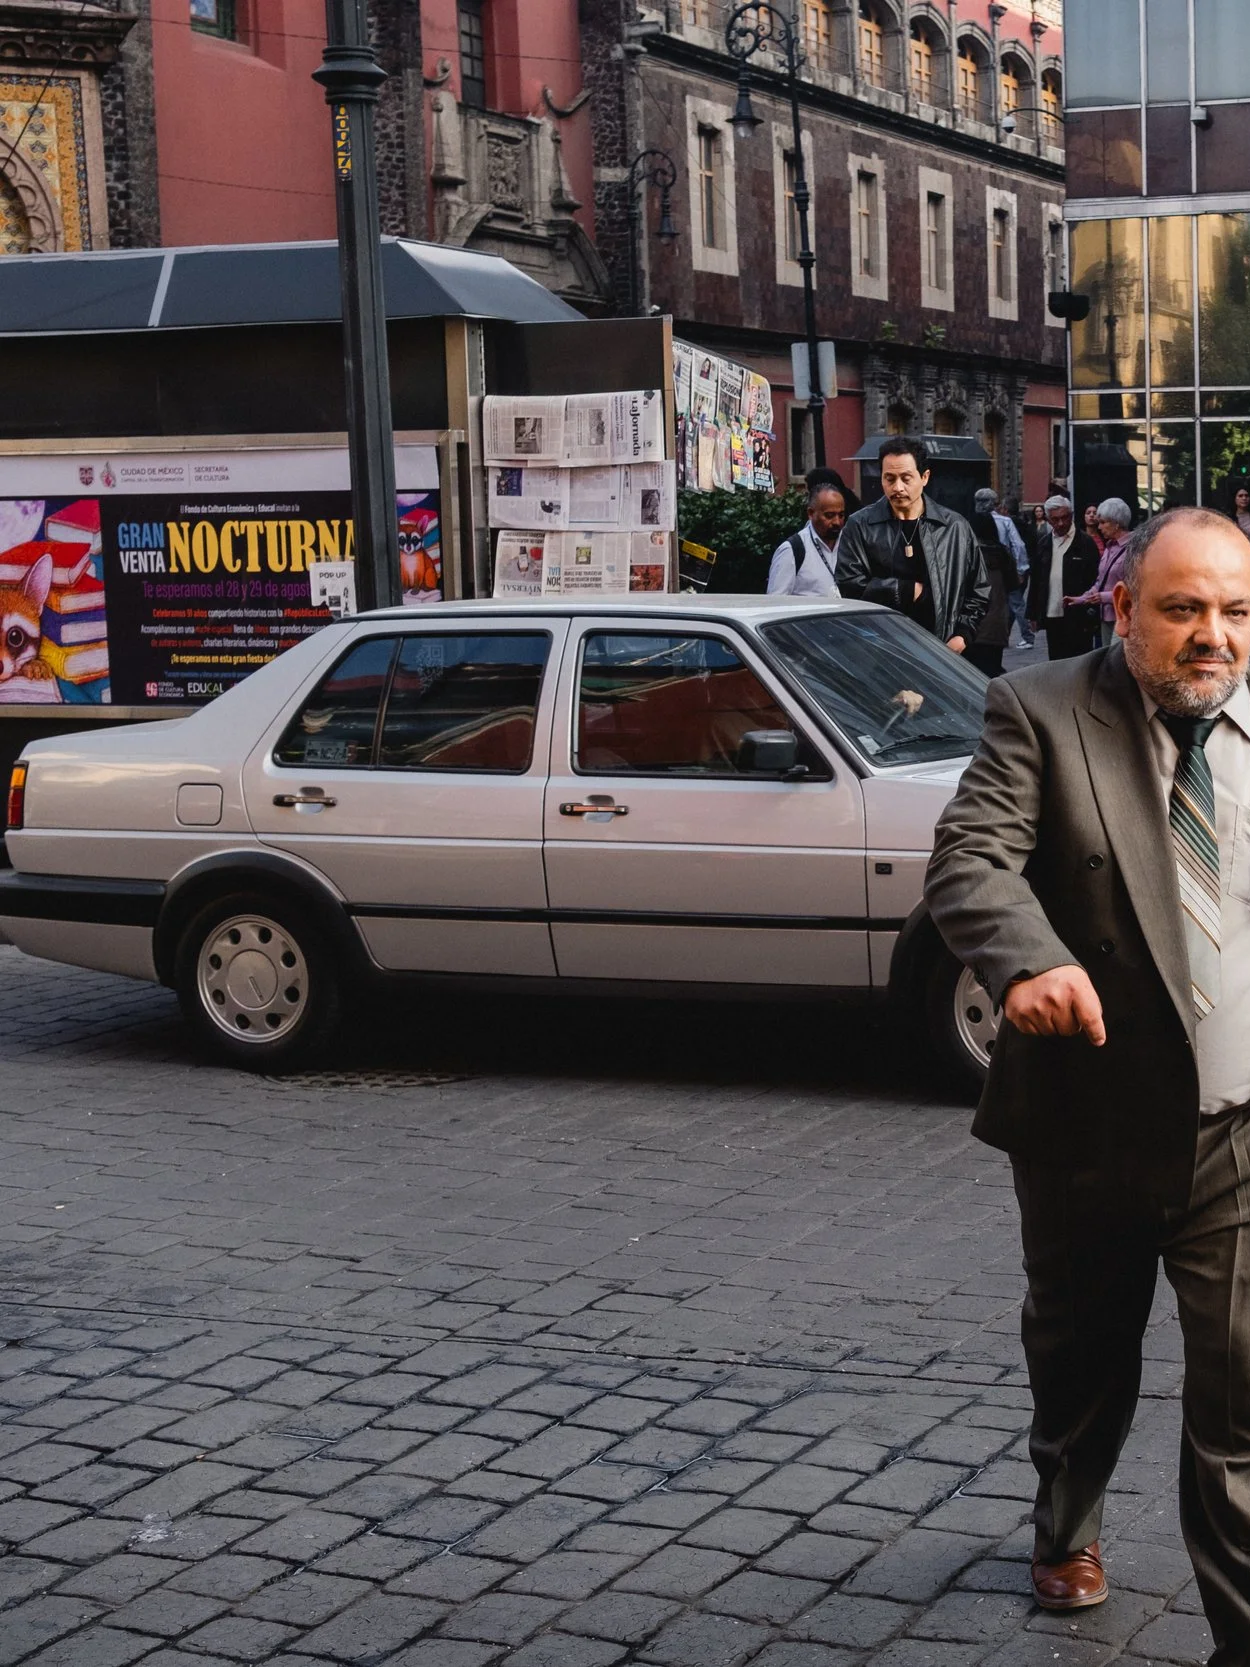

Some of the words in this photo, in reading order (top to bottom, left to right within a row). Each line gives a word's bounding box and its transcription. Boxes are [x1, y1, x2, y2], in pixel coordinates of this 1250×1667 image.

[120, 467, 146, 476] CIUDAD
[147, 467, 156, 476] DE
[158, 466, 184, 476] MÉXICO
[185, 504, 200, 513] Fondo
[201, 504, 207, 513] de
[208, 504, 226, 513] Cultura
[258, 504, 275, 512] Educal
[118, 522, 165, 549] GRAN
[119, 551, 167, 573] VENTA
[143, 581, 154, 597] Te
[155, 583, 213, 601] esperamos
[215, 581, 224, 597] el
[226, 581, 239, 597] 28
[241, 584, 248, 601] y
[249, 581, 263, 597] 29
[264, 580, 277, 597] de
[280, 582, 312, 601] agost
[267, 609, 277, 617] con
[187, 682, 224, 694] EDUCAL
